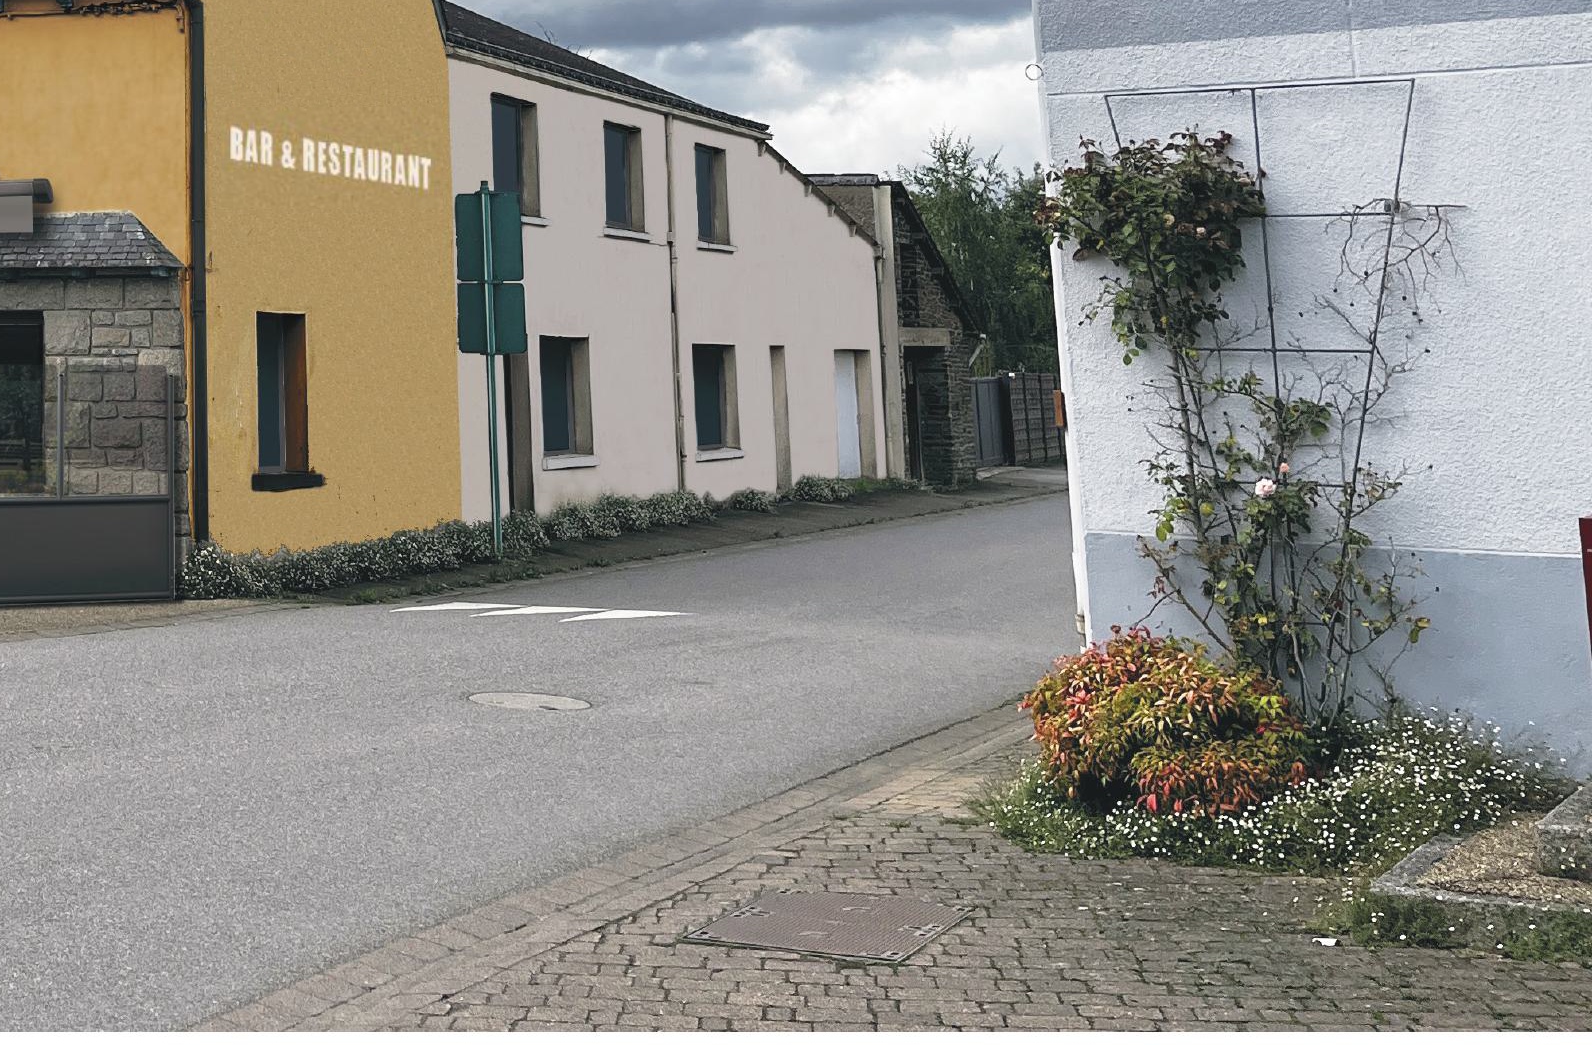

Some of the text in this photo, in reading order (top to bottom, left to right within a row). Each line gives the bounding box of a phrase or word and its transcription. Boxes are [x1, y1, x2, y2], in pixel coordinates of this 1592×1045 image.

[230, 125, 432, 190] BAR & RESTAURANT
